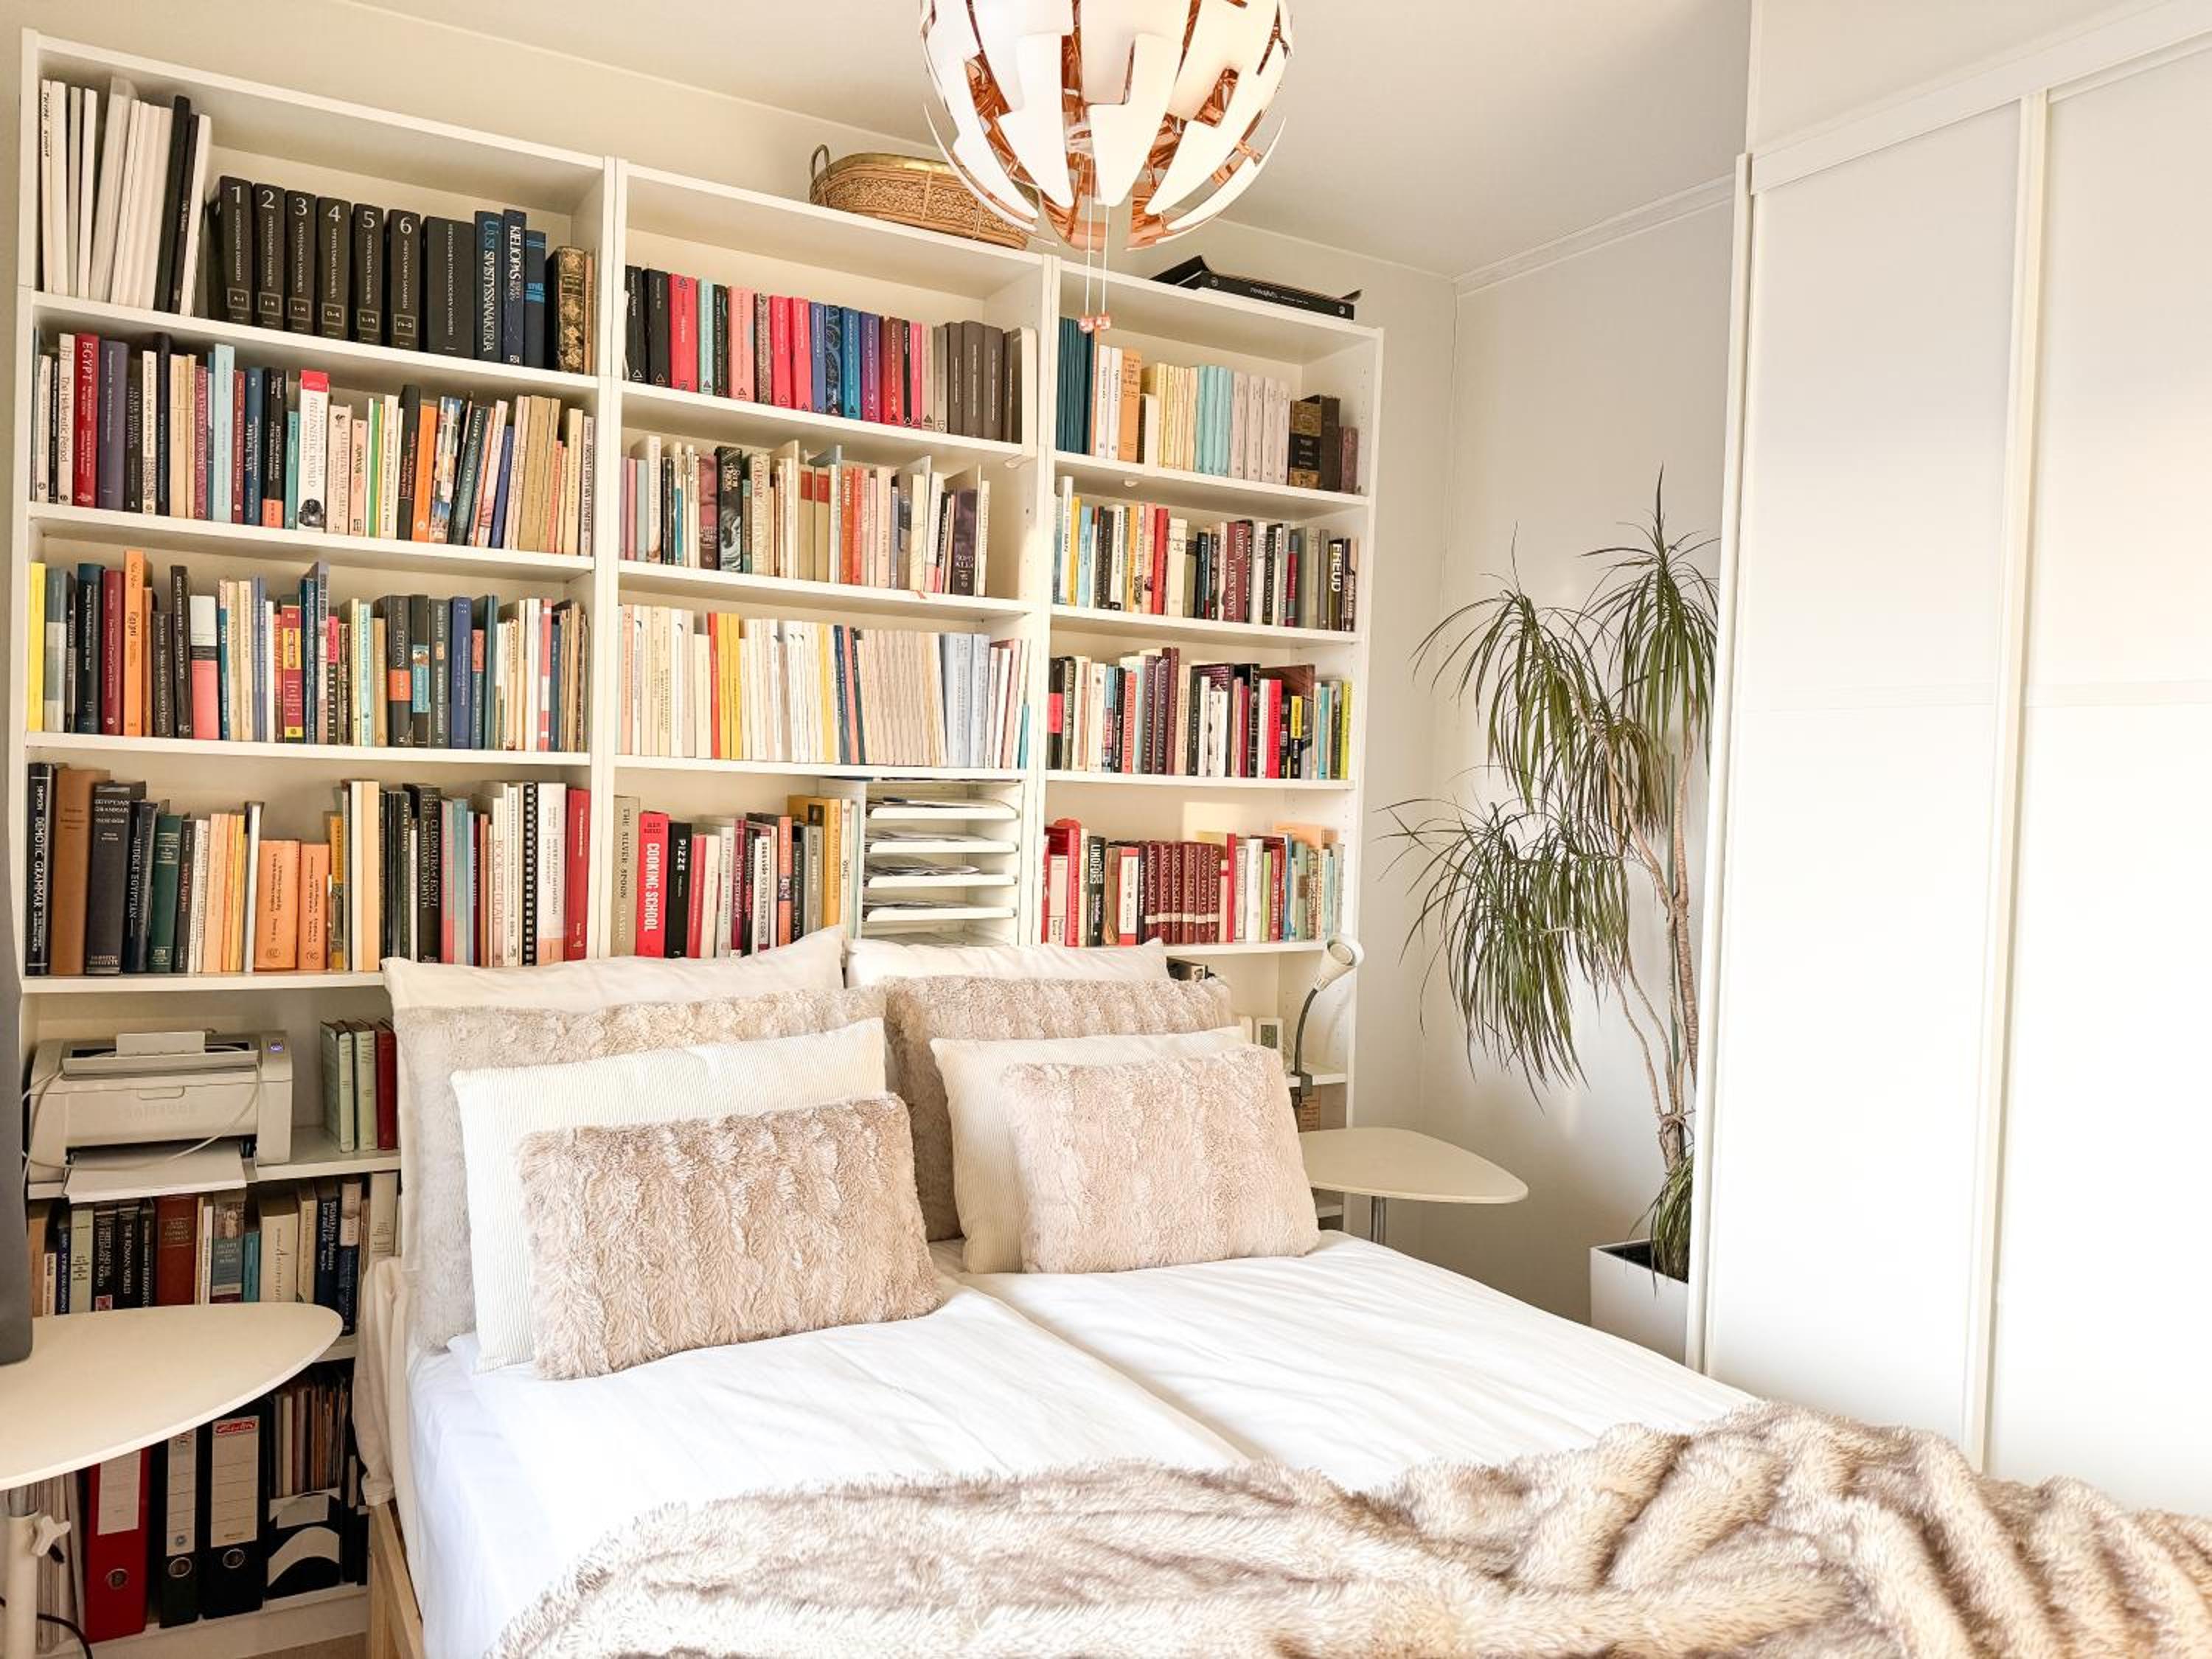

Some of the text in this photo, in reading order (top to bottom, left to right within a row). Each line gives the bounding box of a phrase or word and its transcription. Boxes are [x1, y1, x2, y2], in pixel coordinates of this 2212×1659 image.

[232, 186, 240, 204] 1
[261, 190, 274, 209] 2
[295, 198, 307, 217] 3
[327, 205, 341, 223] 4
[361, 211, 375, 229] 5
[400, 217, 411, 234] 6
[510, 226, 521, 280] KIELIOPAS
[484, 250, 495, 351] SIVISTYSSANAKIRJA
[82, 342, 93, 383] EGYPT
[60, 377, 70, 391] The
[60, 437, 69, 463] Period
[308, 455, 319, 487] WORLD
[754, 461, 763, 498] CAESAR
[1236, 529, 1245, 560] DARWIN
[1332, 543, 1342, 591] FREUD
[35, 785, 44, 810] SIMPSON
[430, 819, 438, 871] CLEOPATRA
[621, 832, 630, 863] SILVER
[677, 839, 687, 872] PIZZE
[34, 816, 44, 908] DEMOTIC GRAMMAR
[422, 872, 429, 883] TO
[1090, 844, 1100, 884] LINDFORS
[128, 838, 142, 919] MIDDLE EGYPTIAN
[429, 880, 438, 908] EGYPT
[619, 869, 628, 898] SPOON
[644, 843, 660, 932] COOKING SCHOOL
[1172, 849, 1180, 911] MARX ENGELS
[1188, 849, 1196, 911] MARX ENGELS
[619, 904, 627, 941] CLASSIC
[329, 1201, 338, 1232] WOMEN
[123, 1224, 133, 1295] THE ROMAN WORLD
